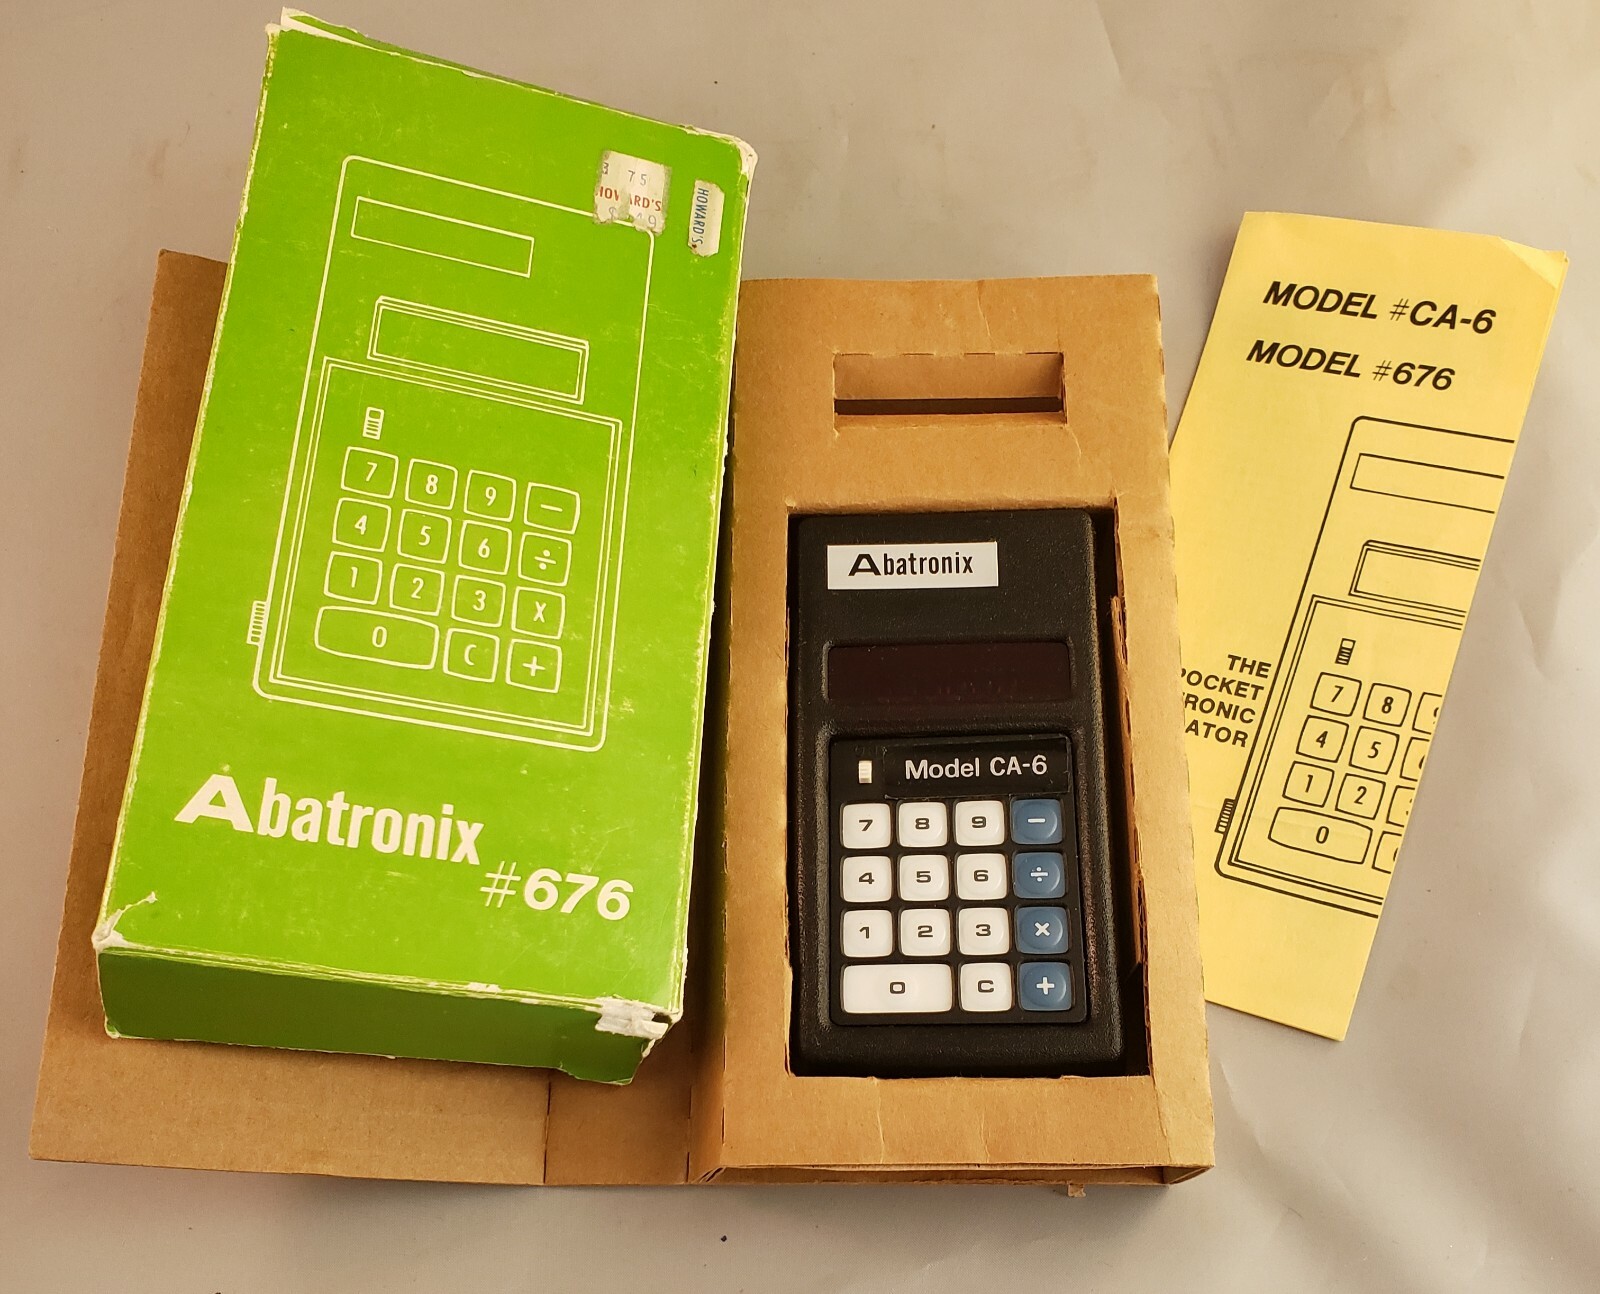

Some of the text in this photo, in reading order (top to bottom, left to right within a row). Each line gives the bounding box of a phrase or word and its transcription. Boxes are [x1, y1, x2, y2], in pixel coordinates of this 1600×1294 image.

[692, 187, 709, 244] HOWARD'S
[1262, 280, 1497, 335] MODEL #CA-6
[1245, 339, 1456, 391] MODEL #676
[365, 461, 378, 482] 7
[425, 474, 439, 495] 8
[485, 486, 497, 506] 9
[354, 515, 368, 535] 4
[418, 525, 432, 546] 5
[477, 538, 491, 559] 6
[847, 551, 974, 577] Abatronix
[351, 566, 358, 588] 1
[411, 577, 424, 599] 2
[472, 589, 487, 612] 3
[371, 625, 388, 648] 0
[463, 643, 477, 666] C
[1227, 654, 1272, 679] THE
[1182, 691, 1256, 725] RONIC
[1330, 685, 1394, 714] 7 8
[1185, 718, 1248, 748] ATOR
[1315, 730, 1382, 759] 4 5
[905, 754, 1048, 780] Model CA-6
[1304, 774, 1368, 805] 1 2
[174, 773, 484, 866] Abatronix
[858, 819, 874, 832] 7
[915, 817, 930, 830] 8
[971, 815, 987, 829] 9
[1315, 825, 1330, 845] 0
[477, 859, 634, 921] #676
[858, 872, 875, 885] 4
[916, 870, 932, 884] 5
[973, 869, 989, 882] 6
[859, 926, 870, 939] 1
[917, 925, 934, 938] 2
[975, 923, 992, 937] 3
[977, 979, 995, 993] C
